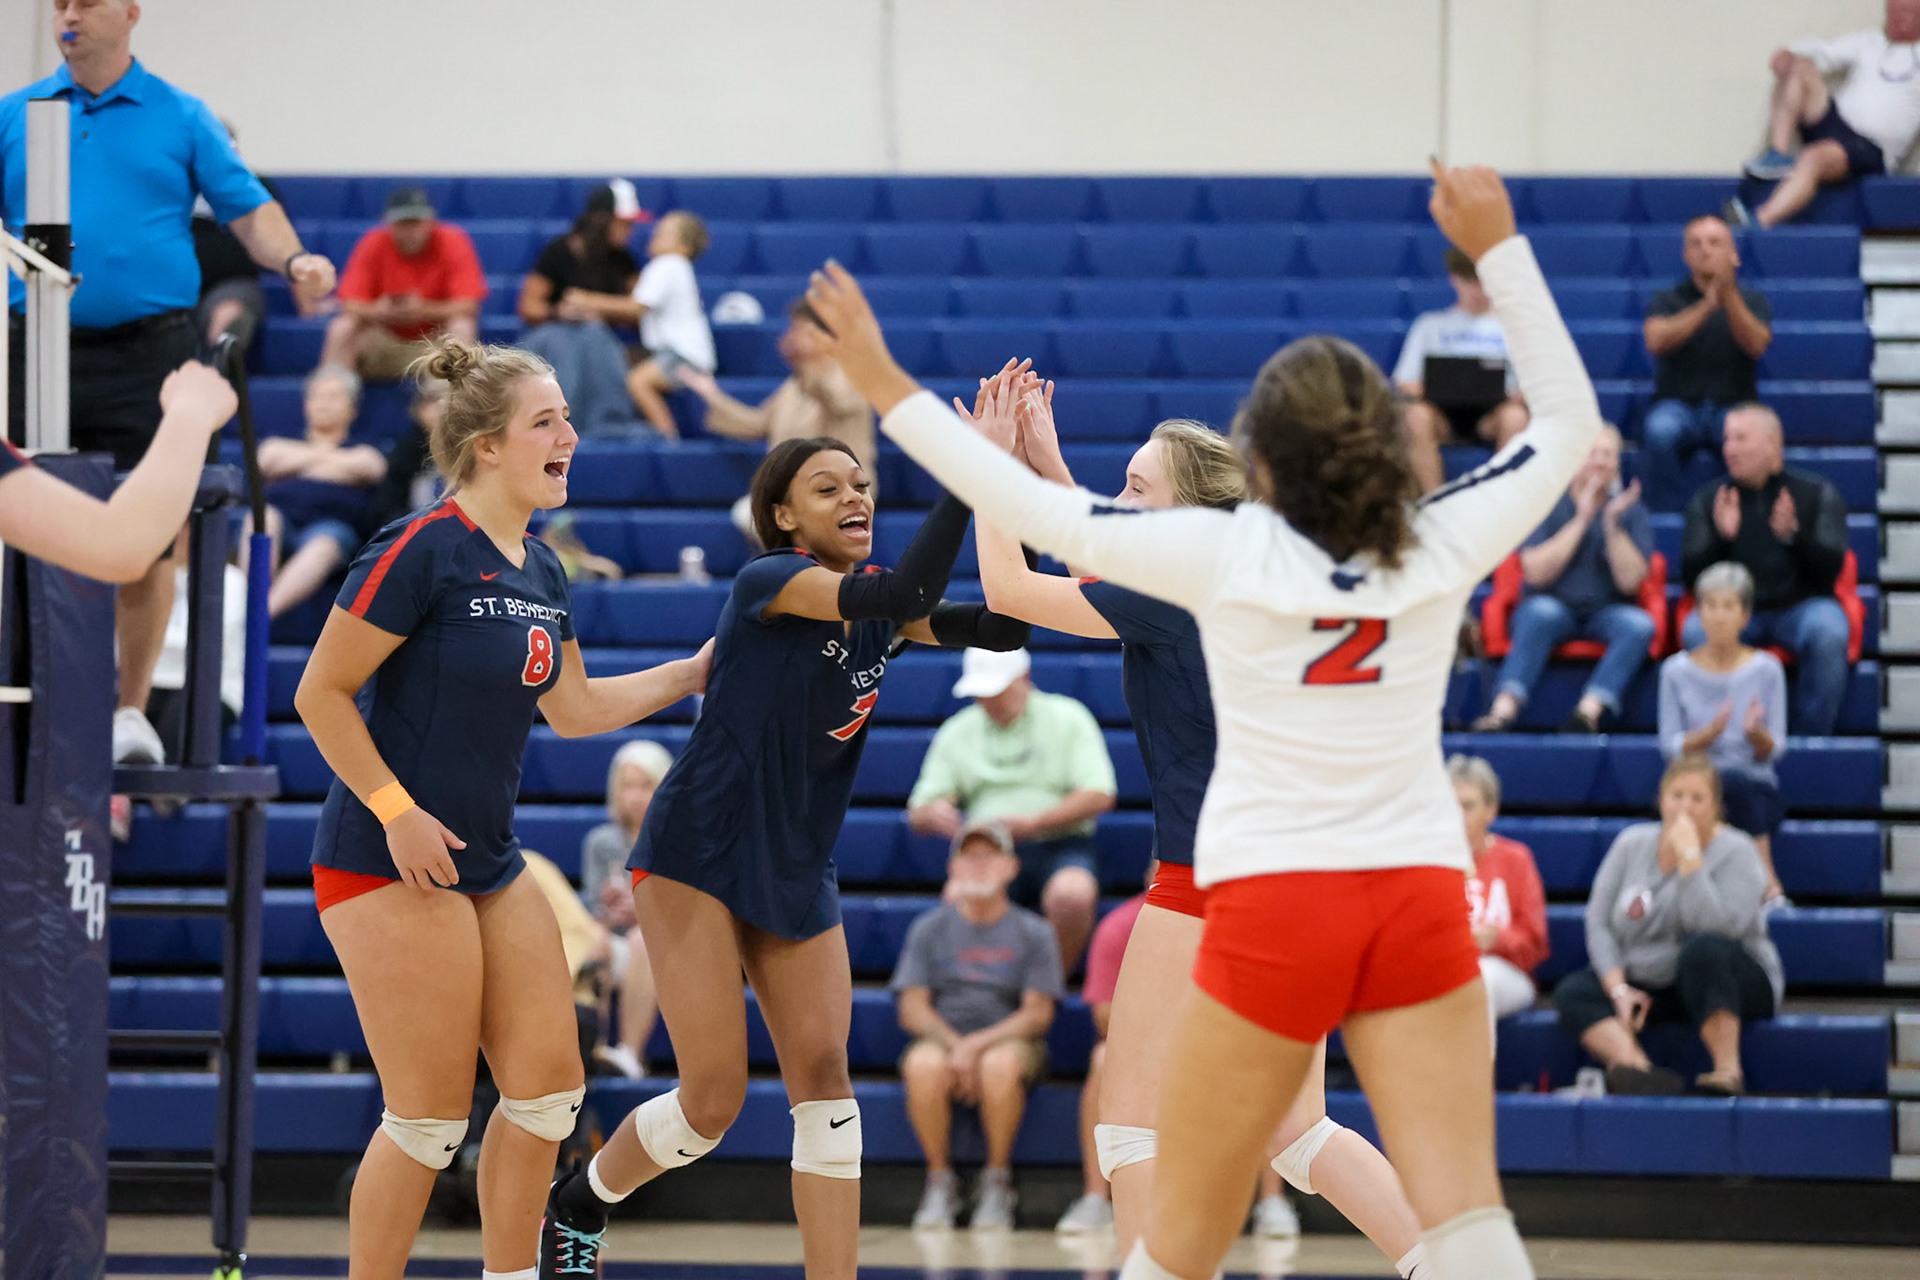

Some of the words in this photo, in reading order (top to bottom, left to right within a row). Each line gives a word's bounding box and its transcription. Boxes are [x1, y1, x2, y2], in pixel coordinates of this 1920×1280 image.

[469, 597, 502, 617] ST.
[521, 625, 554, 687] 8
[821, 639, 849, 670] ST.
[1302, 617, 1388, 685] 2
